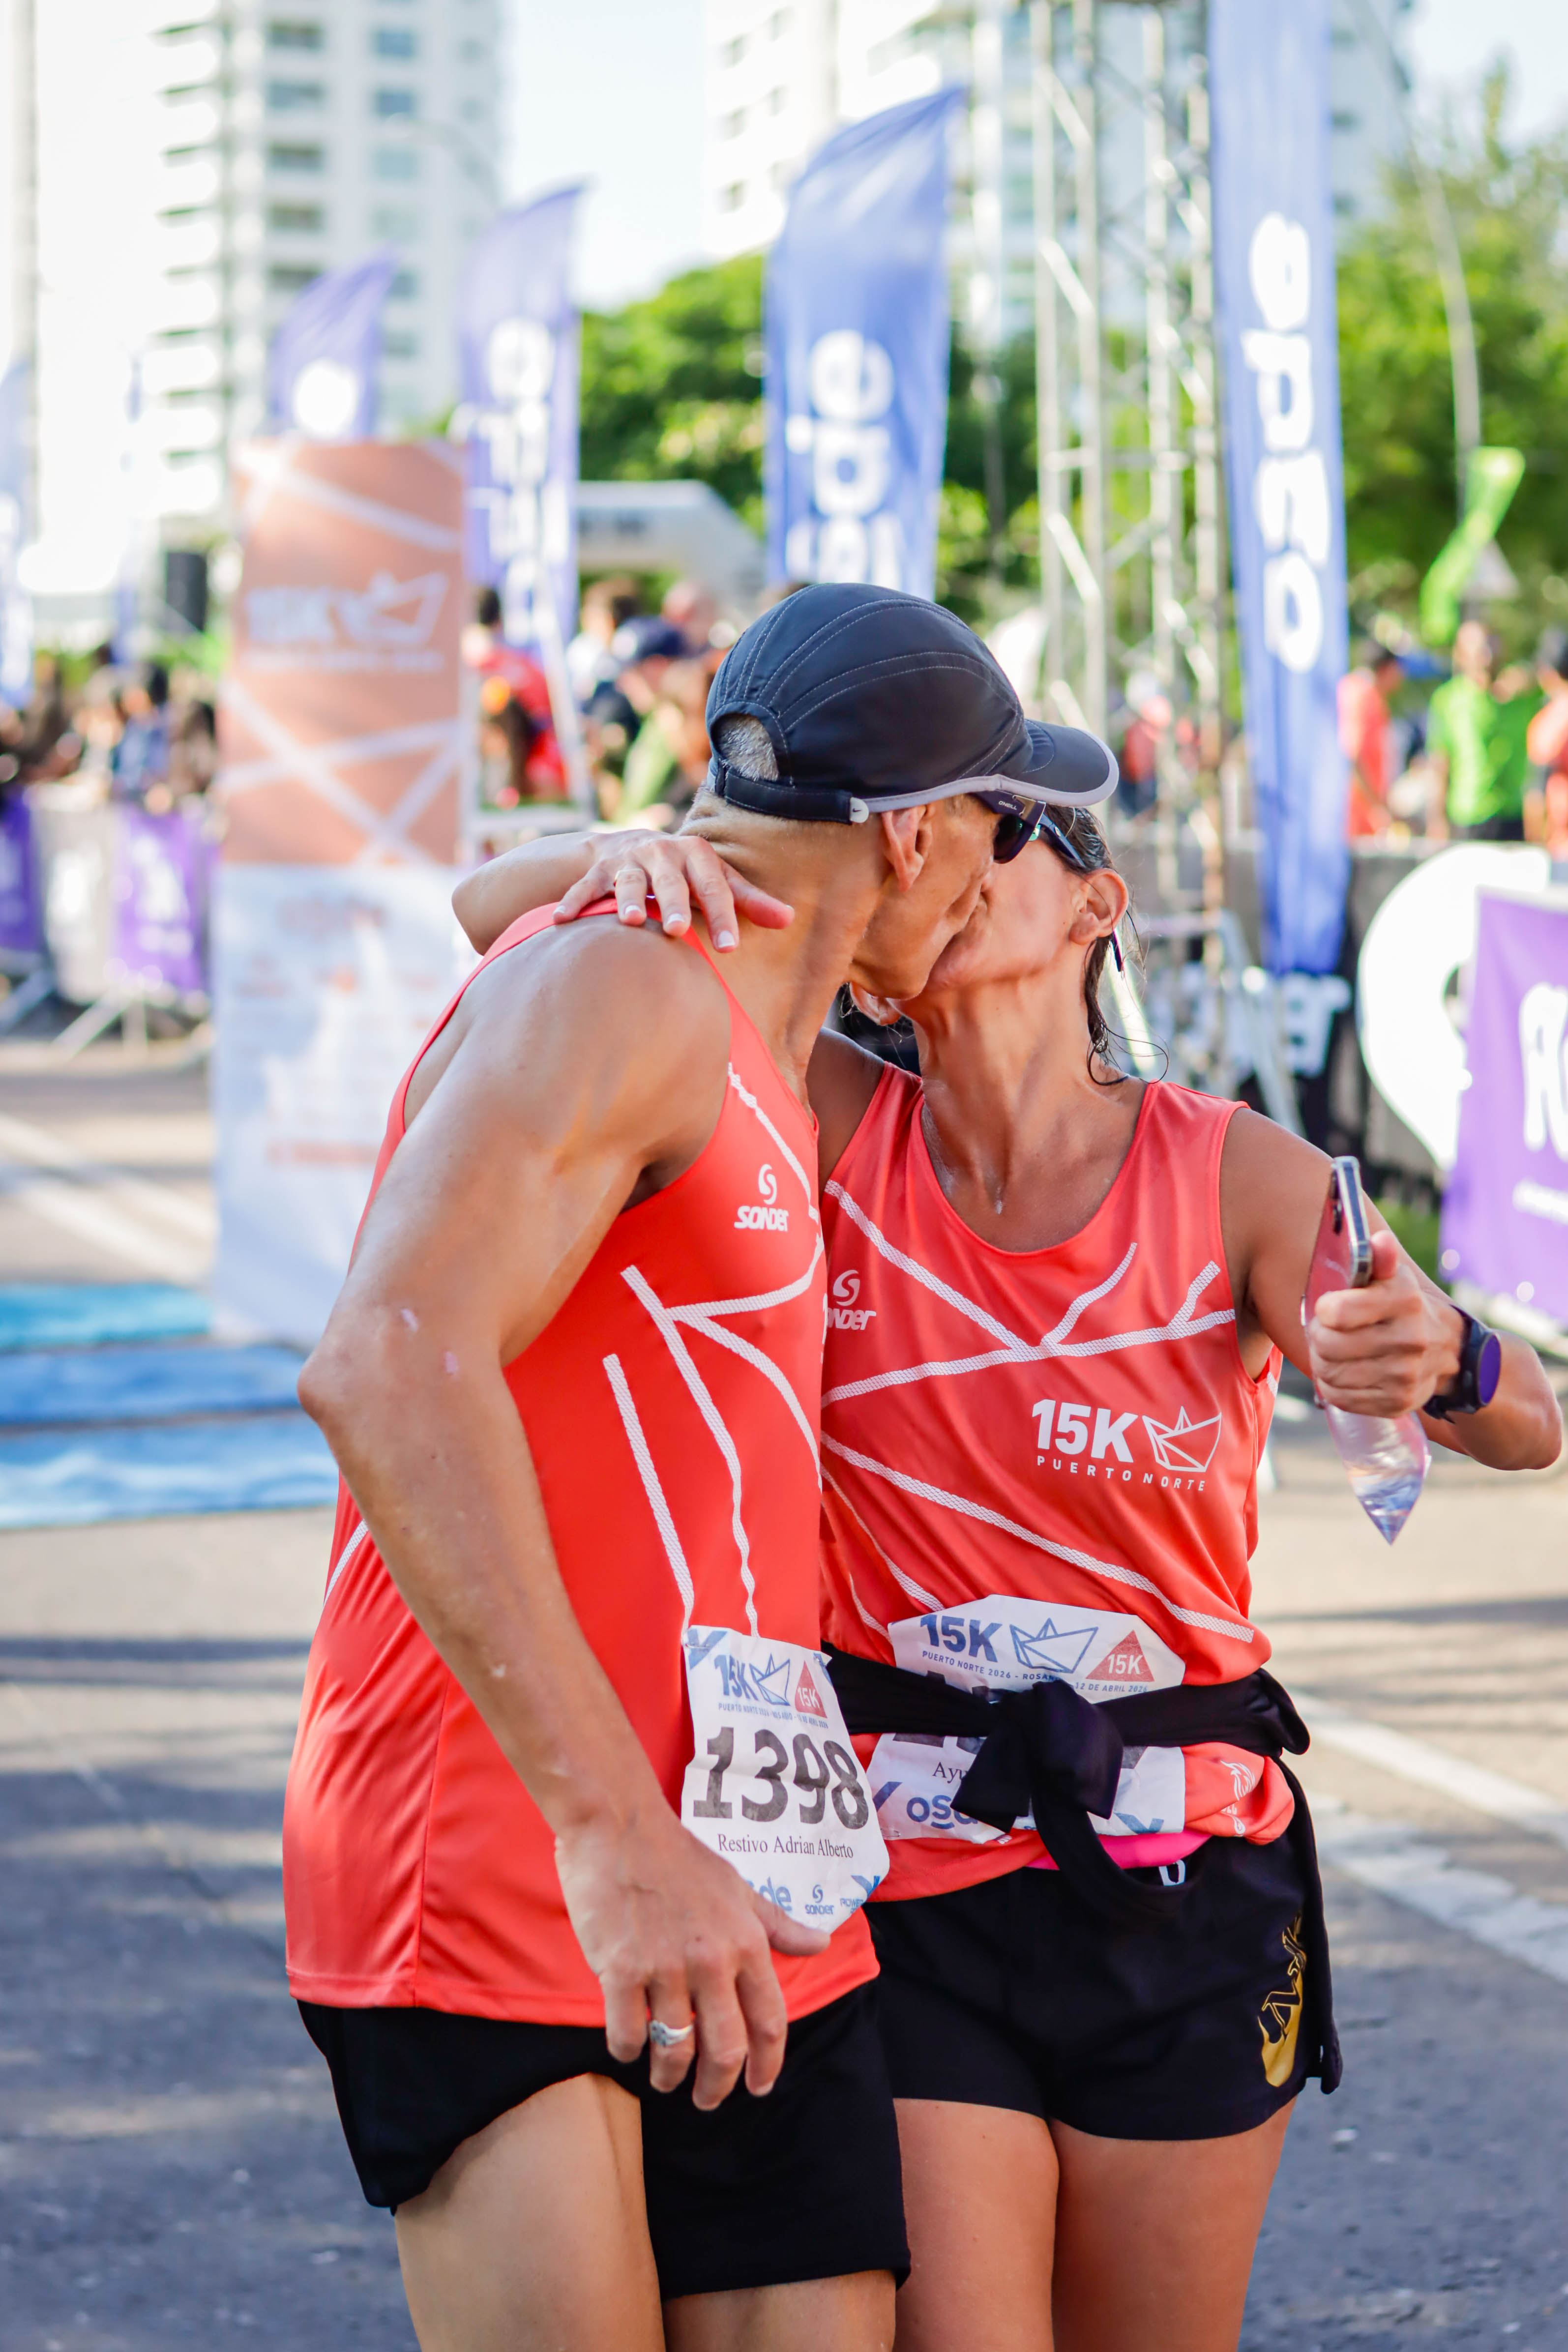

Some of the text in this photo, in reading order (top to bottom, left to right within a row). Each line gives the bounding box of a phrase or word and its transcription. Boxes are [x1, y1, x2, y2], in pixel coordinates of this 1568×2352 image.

[1032, 1399, 1139, 1463] 15K
[1037, 1455, 1206, 1491] PUERTO NORTE
[919, 1614, 1002, 1663] 15K
[714, 1654, 759, 1701] 15K
[922, 1650, 955, 1666] PUERTO
[957, 1660, 985, 1674] NORTE
[988, 1669, 1011, 1679] 2026
[1107, 1653, 1143, 1675] 15K
[718, 1703, 742, 1712] PUERTO
[797, 1686, 821, 1709] 15K
[693, 1726, 869, 1830] 1398
[717, 1833, 854, 1859] Restivo Adrian Alberto
[747, 1876, 792, 1911] de
